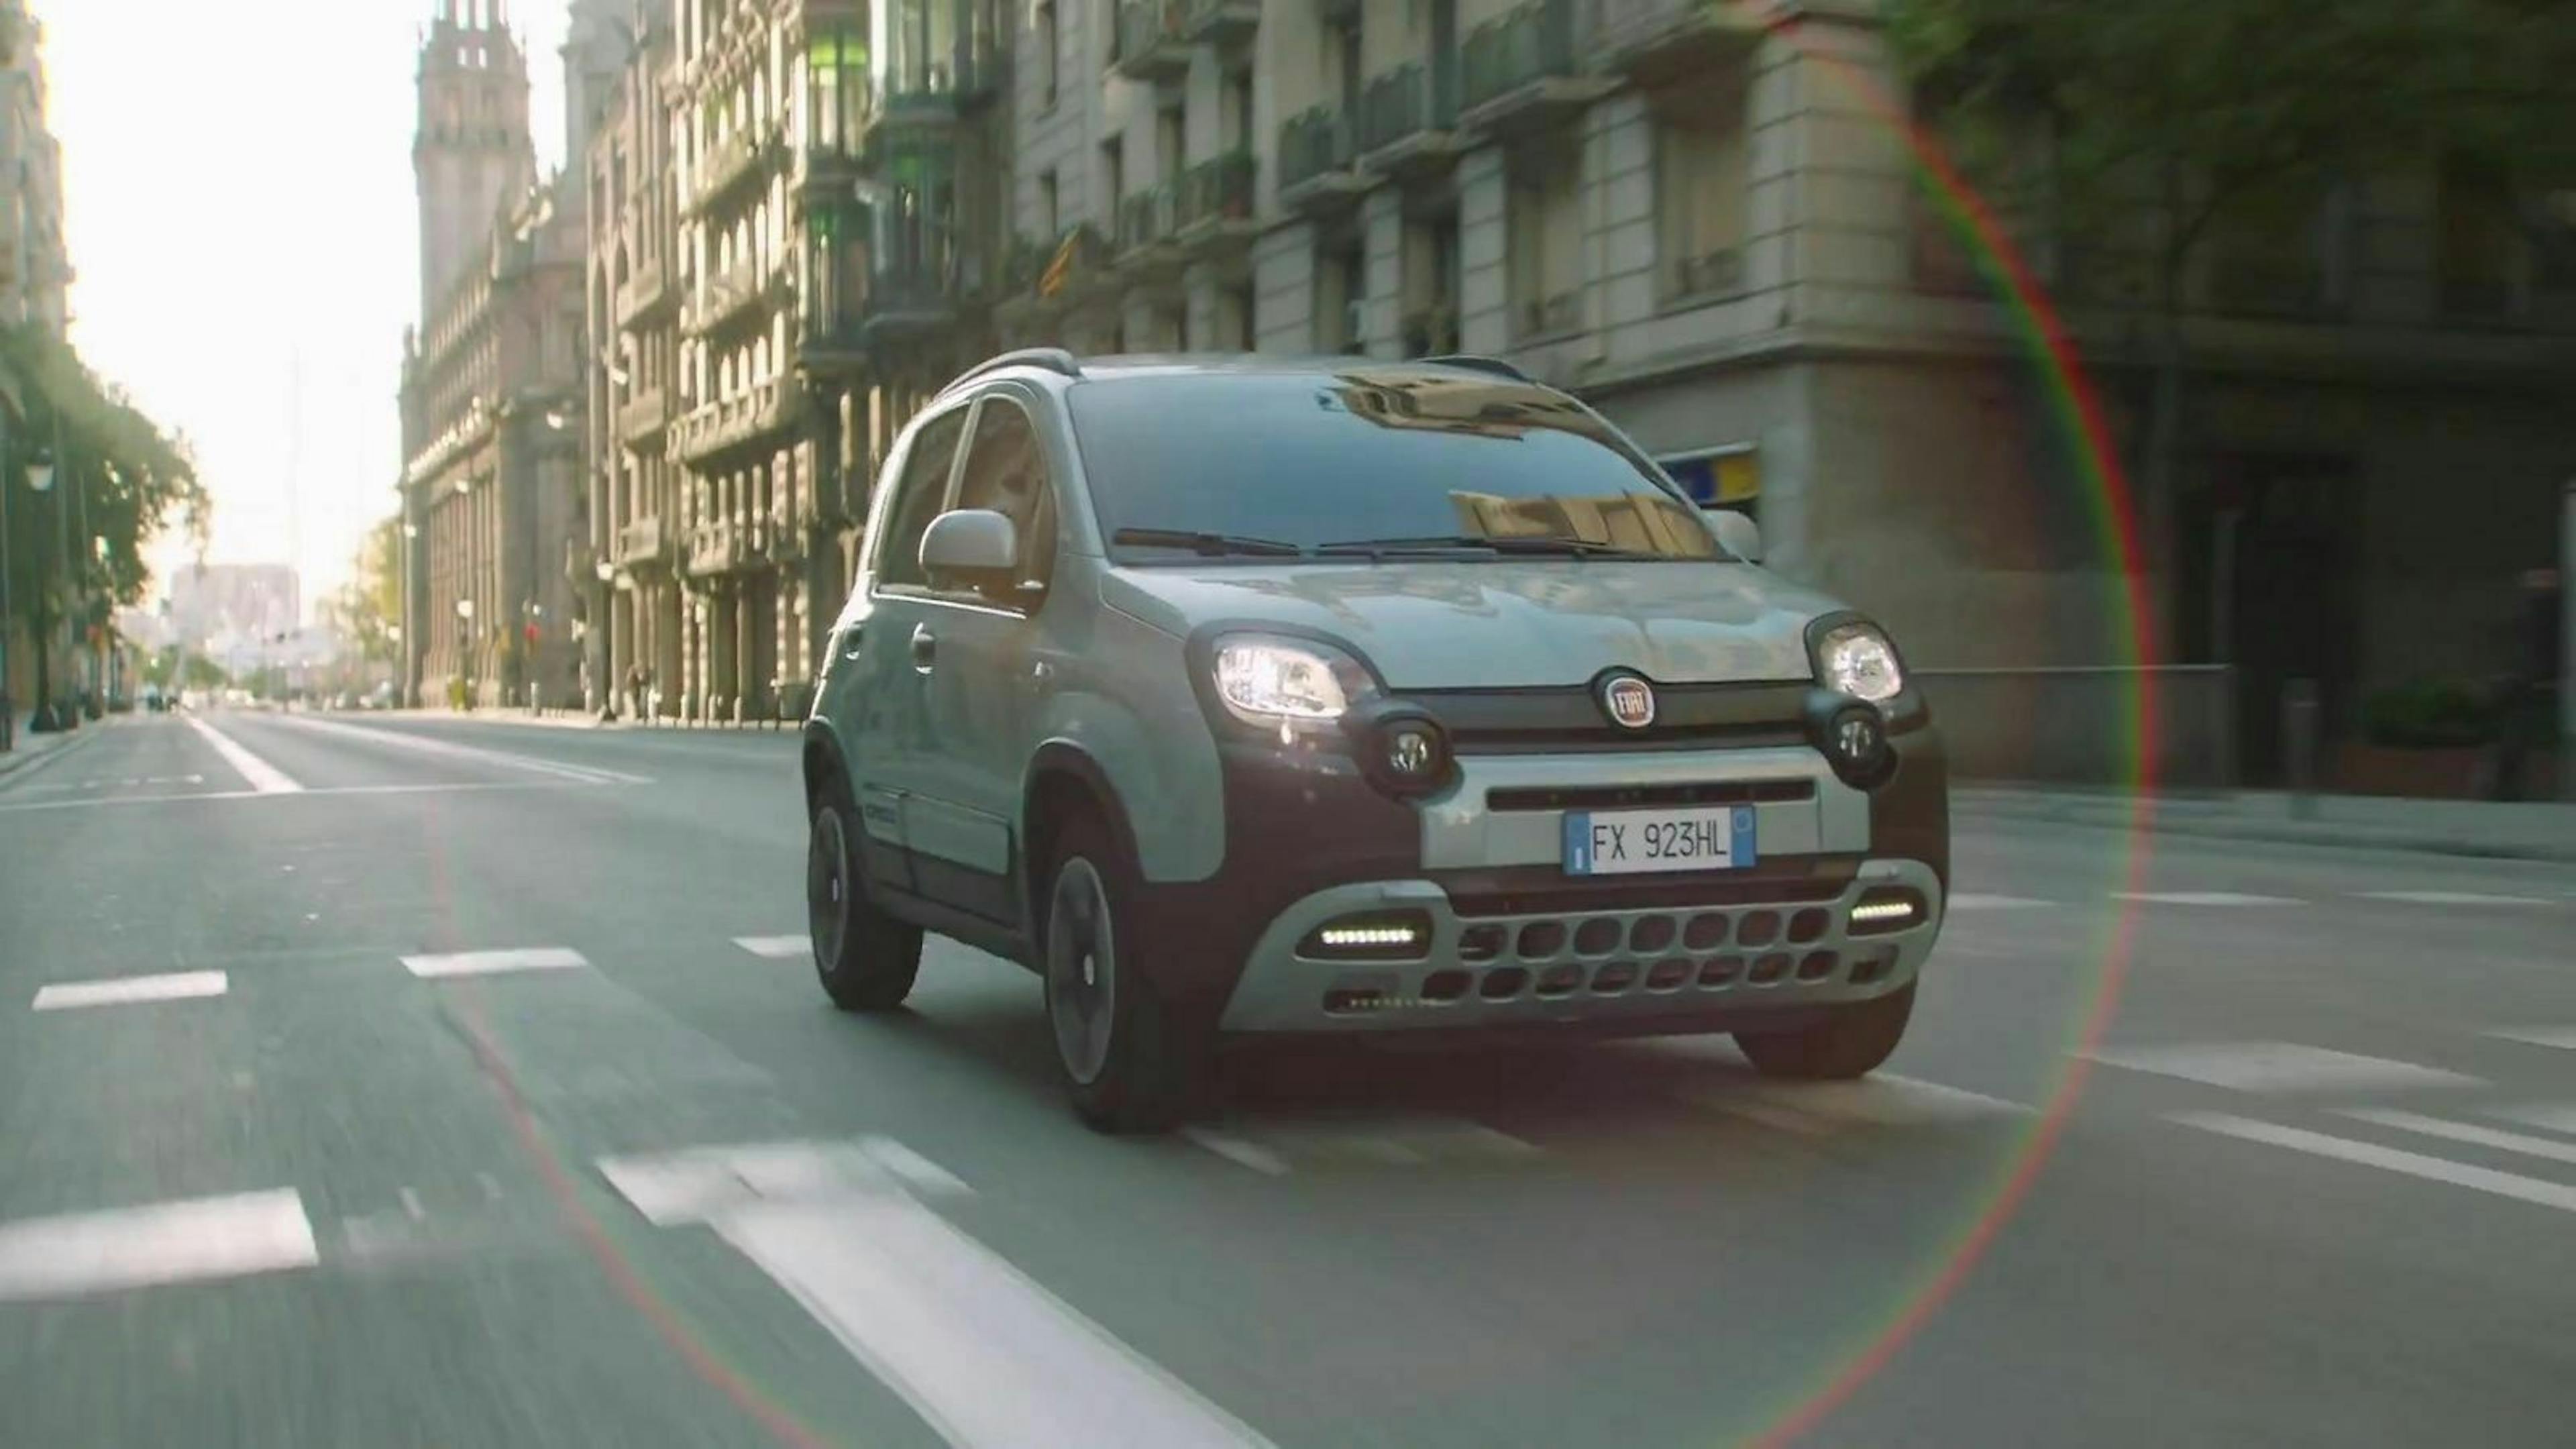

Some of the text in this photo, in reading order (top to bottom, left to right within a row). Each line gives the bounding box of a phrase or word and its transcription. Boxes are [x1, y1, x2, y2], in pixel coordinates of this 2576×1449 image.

[1615, 691, 1646, 714] FIAT
[1593, 819, 1727, 861] FX 923HL
